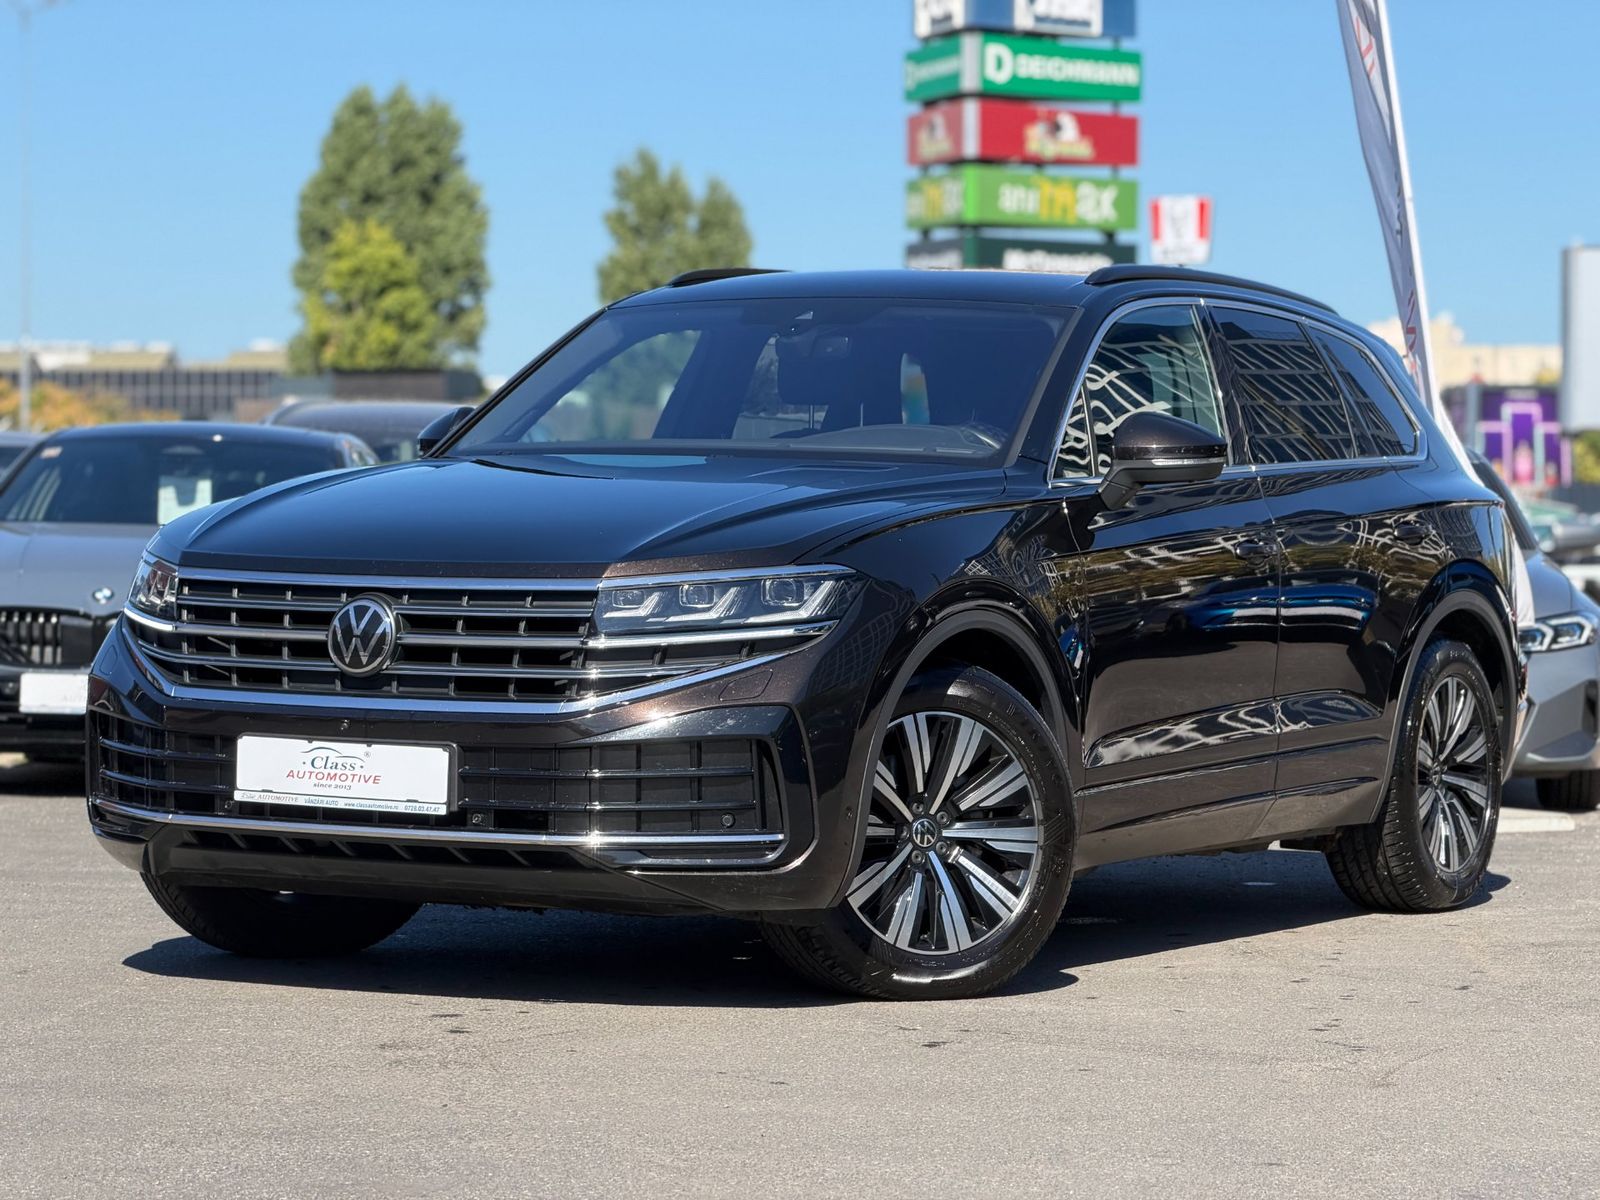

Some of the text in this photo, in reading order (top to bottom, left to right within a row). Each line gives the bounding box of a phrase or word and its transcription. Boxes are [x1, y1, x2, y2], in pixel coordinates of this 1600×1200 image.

[310, 755, 357, 771] Class
[286, 769, 382, 785] AUTOMOTIVE
[257, 793, 299, 802] AUTOMOTIVE
